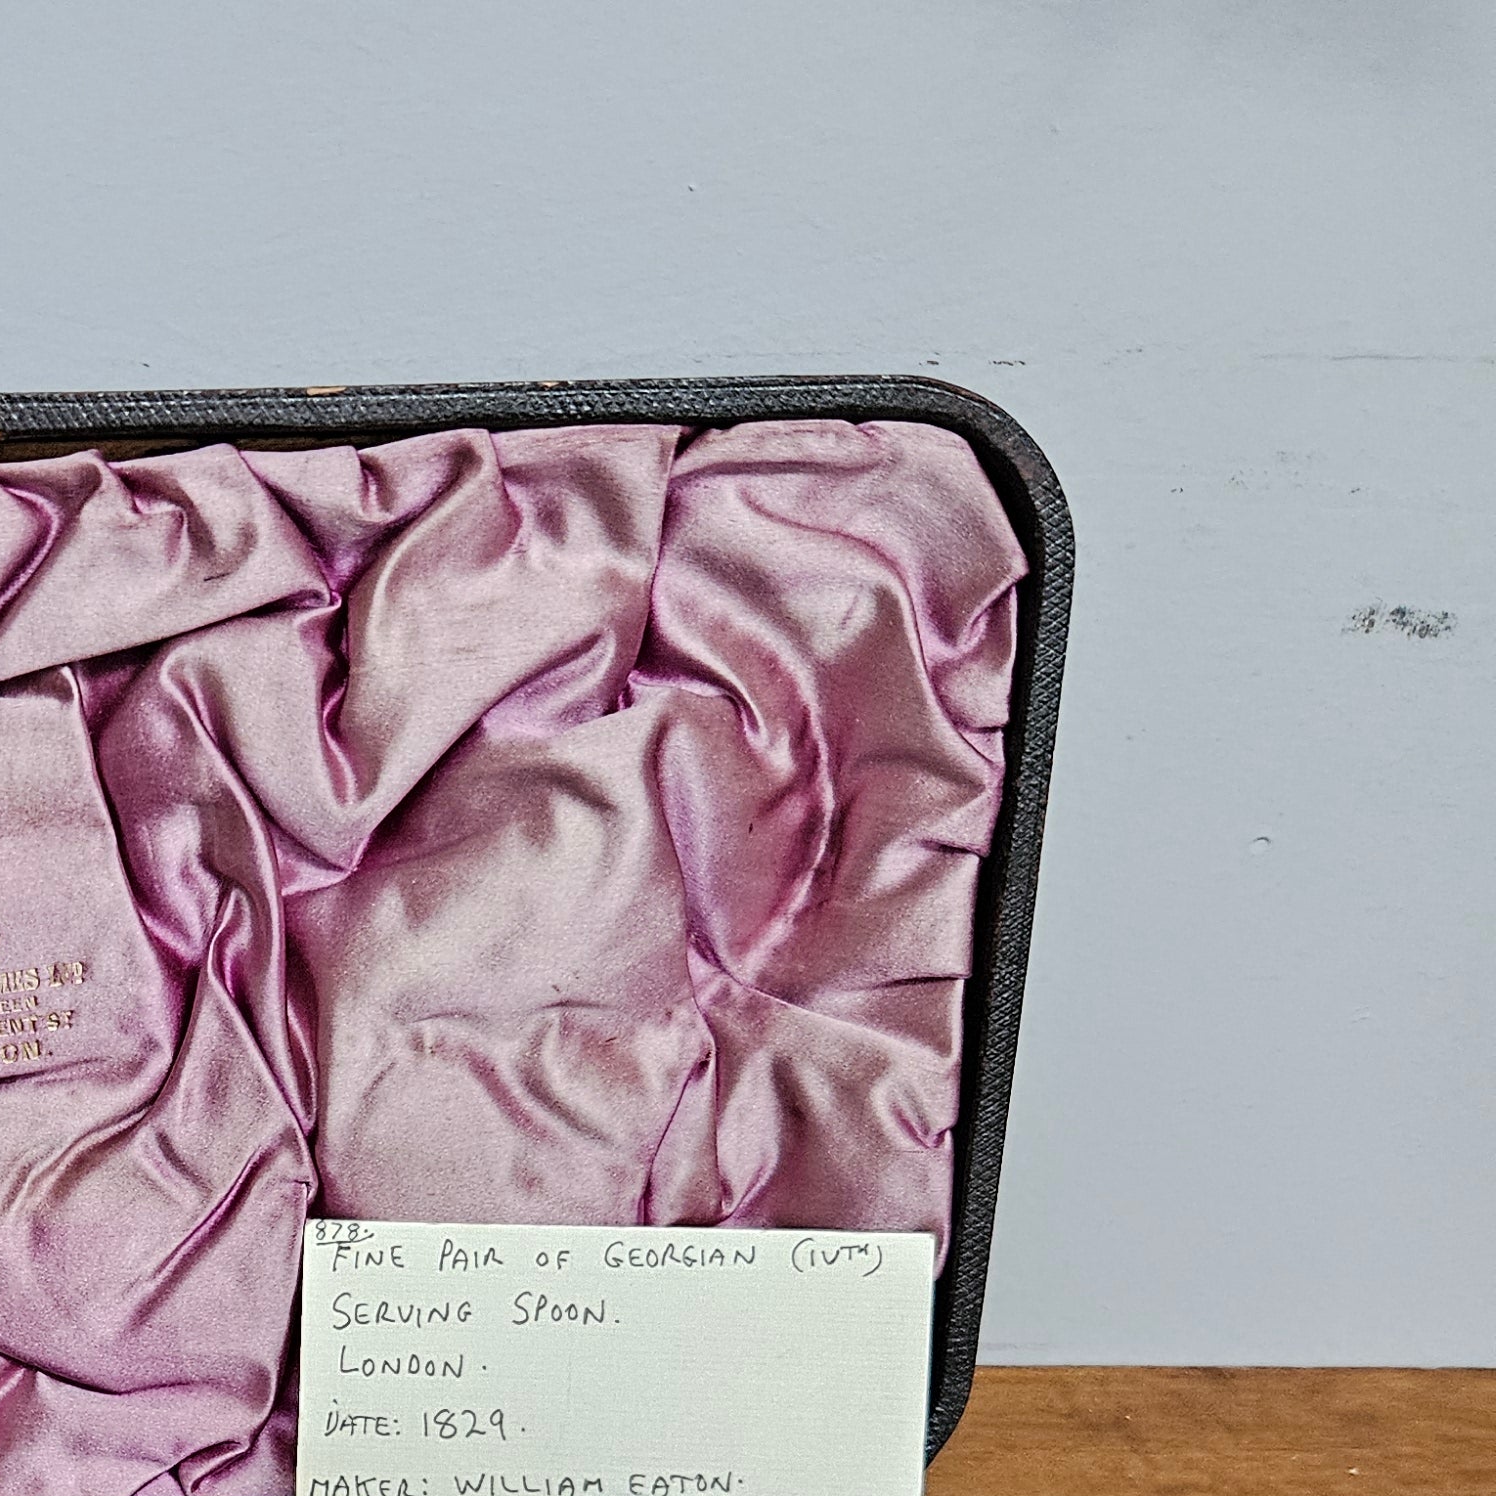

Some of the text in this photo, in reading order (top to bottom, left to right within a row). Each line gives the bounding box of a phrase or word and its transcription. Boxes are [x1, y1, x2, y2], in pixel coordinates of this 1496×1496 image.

[332, 1244, 405, 1272] FINE
[439, 1239, 504, 1271] PAIR
[536, 1250, 571, 1269] OF
[604, 1241, 756, 1268] GEORGIAN
[333, 1291, 620, 1330] SERVING SPOON.
[324, 1410, 401, 1437] DATE:
